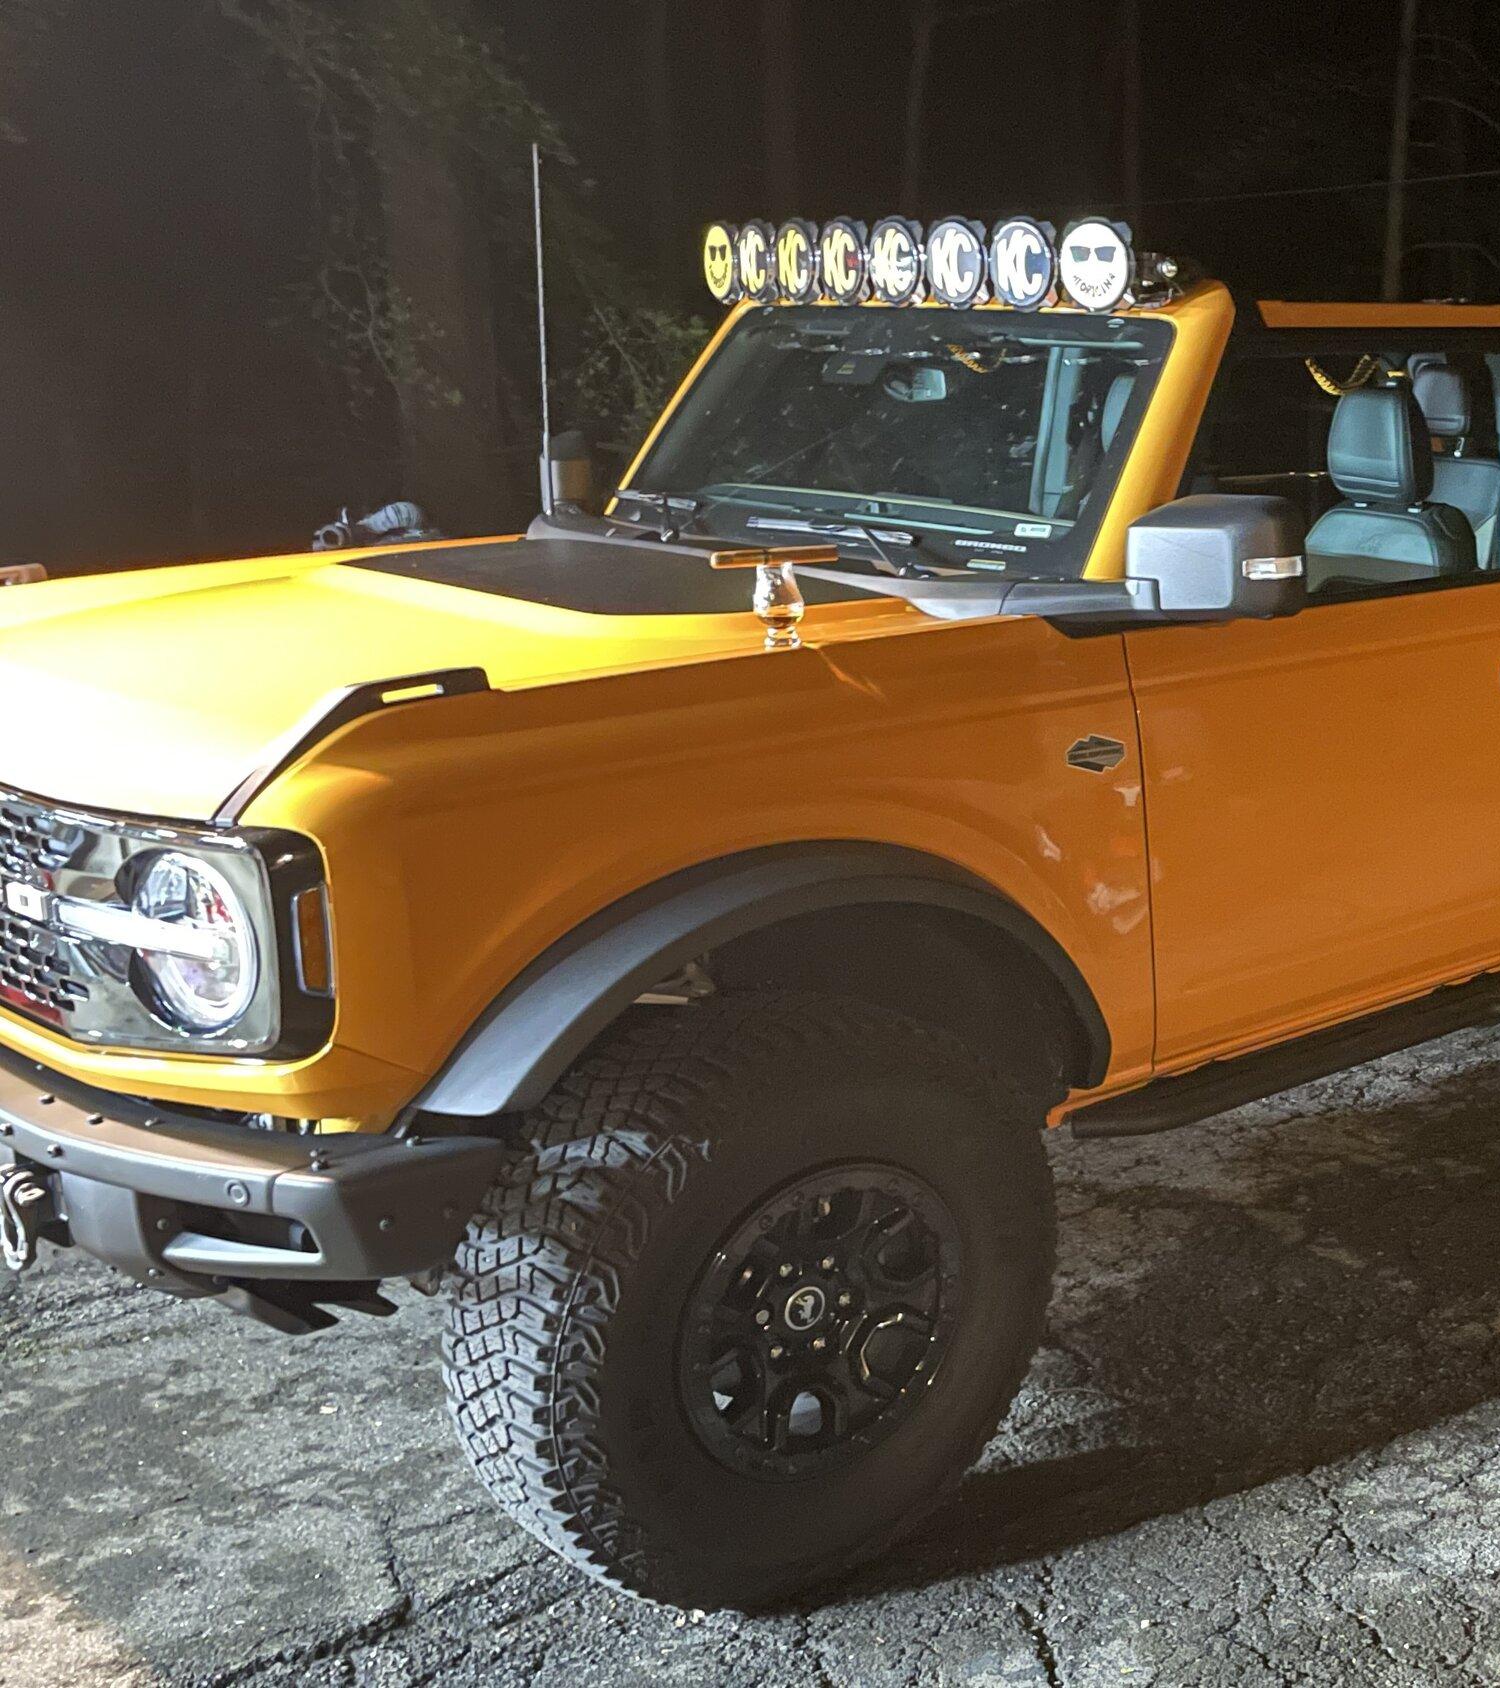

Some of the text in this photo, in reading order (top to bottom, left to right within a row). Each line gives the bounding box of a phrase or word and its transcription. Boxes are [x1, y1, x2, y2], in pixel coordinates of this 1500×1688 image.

[740, 231, 765, 293] KC
[779, 230, 807, 293] KC
[823, 229, 856, 295] KC
[875, 228, 910, 296] KC
[932, 229, 974, 297] KC
[997, 230, 1042, 299] KC
